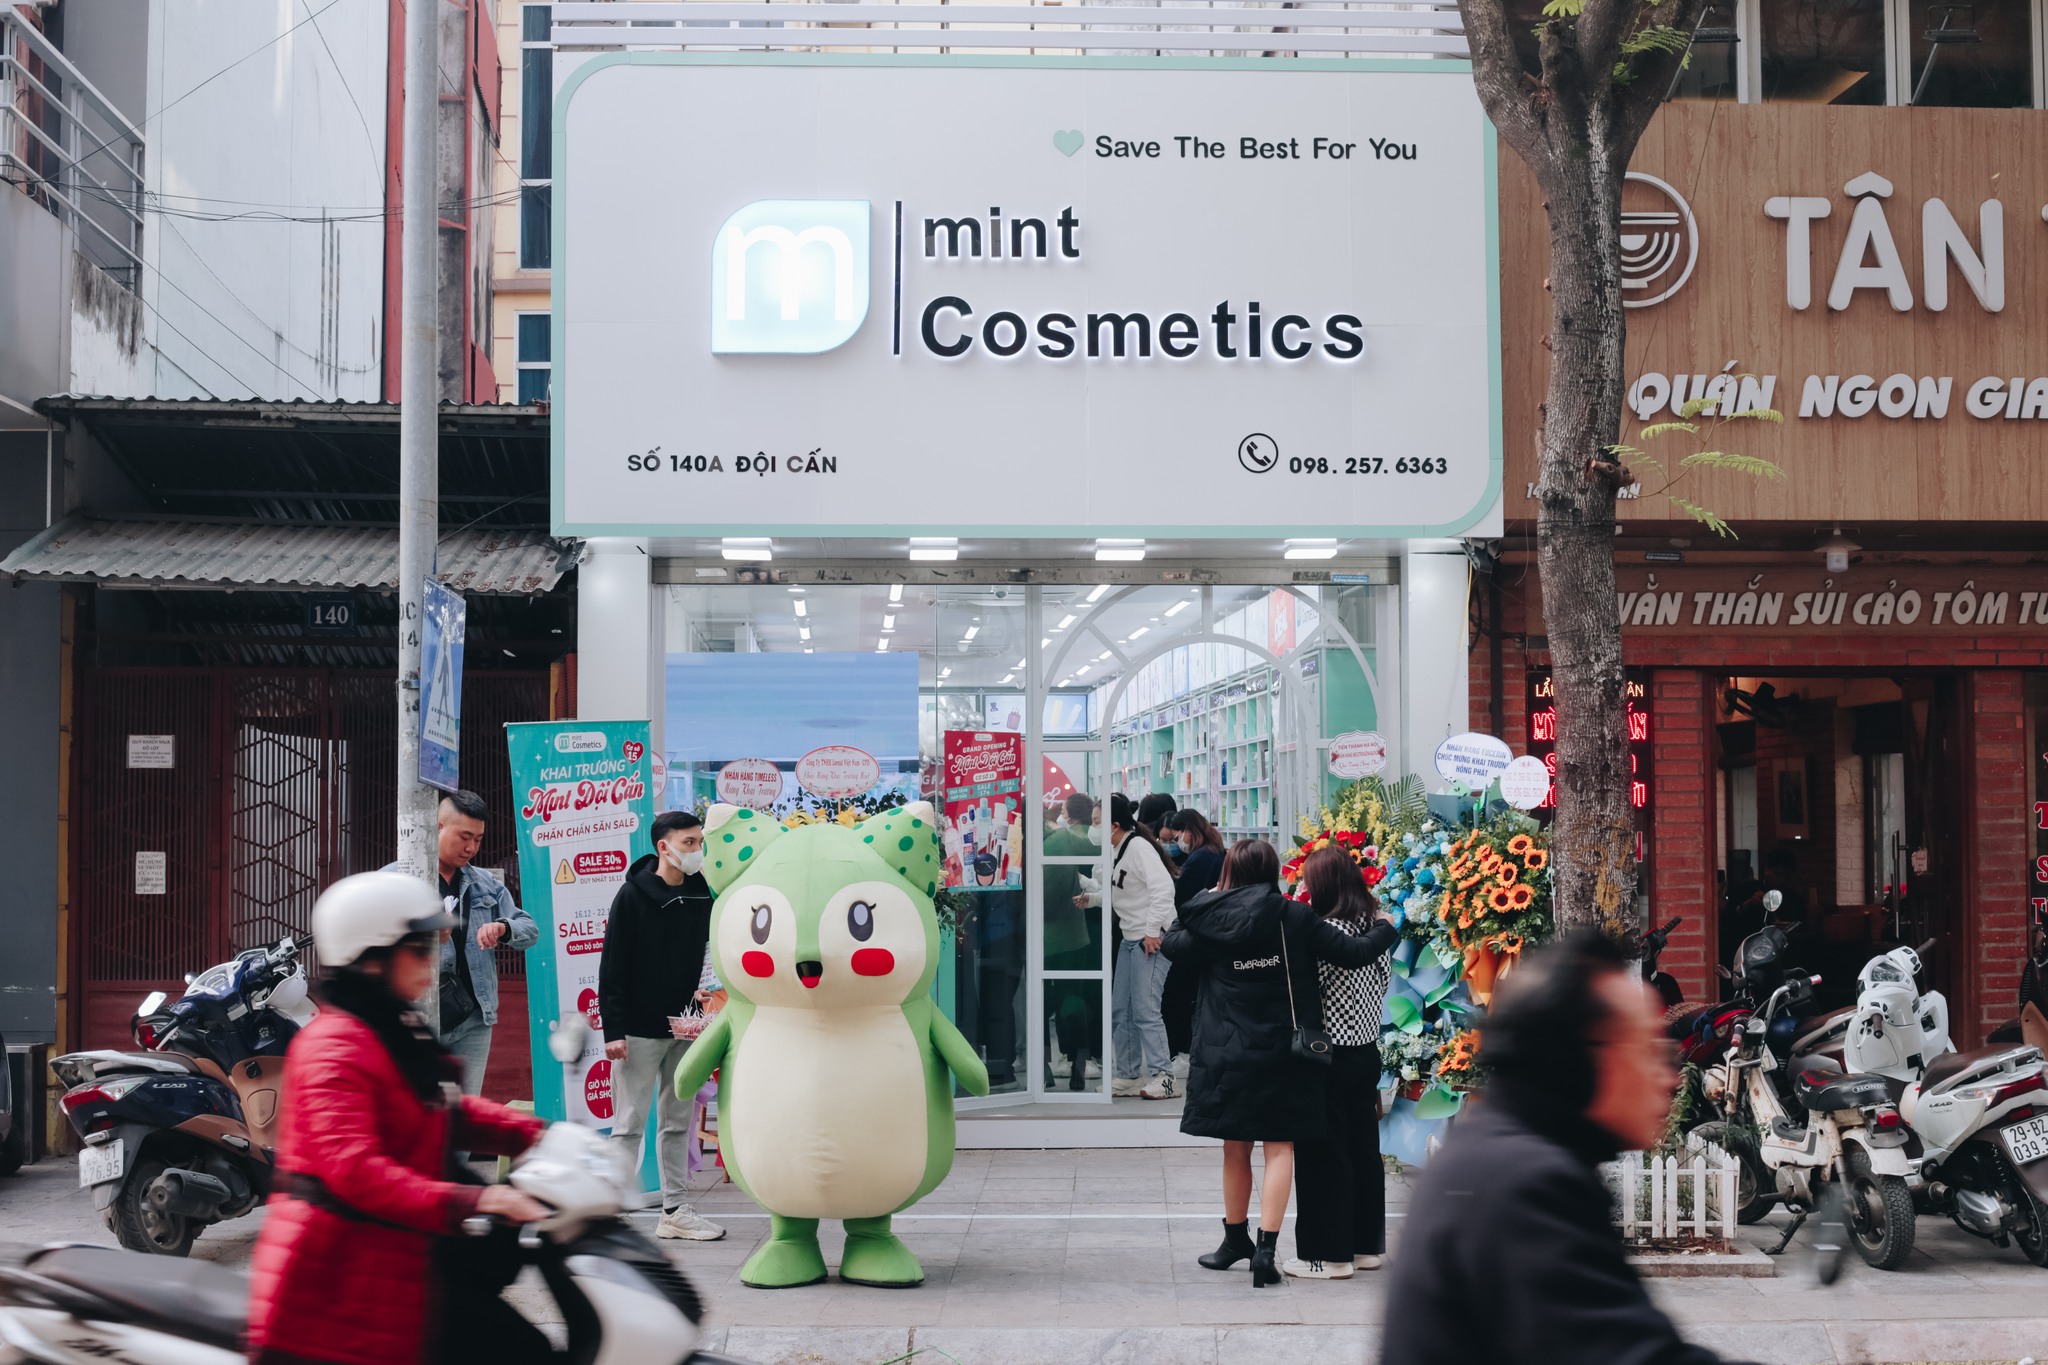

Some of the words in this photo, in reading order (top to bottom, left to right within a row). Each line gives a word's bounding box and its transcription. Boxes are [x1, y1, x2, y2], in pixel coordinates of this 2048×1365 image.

[1095, 136, 1161, 160] Save
[1174, 136, 1226, 160] The
[1239, 137, 1301, 160] Best
[1313, 137, 1357, 161] For
[1369, 138, 1418, 161] You
[922, 205, 1082, 259] mint
[1763, 171, 2005, 312] TÂN
[919, 295, 1366, 360] Cosmetics
[1627, 360, 1776, 421] QUÁN
[1799, 374, 1953, 419] NGON
[627, 446, 662, 474] SỐ
[670, 454, 724, 474] 140A
[735, 450, 777, 479] ĐỘI
[786, 447, 837, 474] CẤN
[1395, 457, 1449, 475] 6363
[1692, 574, 1784, 626] THẮN
[1788, 578, 1848, 625] SỦI
[1853, 579, 1922, 625] CẢO
[1932, 580, 2009, 625] TÔM
[314, 605, 350, 625] 140
[572, 740, 602, 749] Cosmetics
[983, 742, 1006, 750] OPENING
[1481, 748, 1507, 759] EUCERIN
[628, 752, 638, 760] 15
[1472, 757, 1486, 766] KHAI
[540, 766, 572, 781] KHAI
[575, 760, 626, 777] TRƯƠNG
[755, 772, 777, 782] TIMELESS
[523, 788, 572, 822] Mint
[574, 780, 611, 810] Đội
[611, 772, 644, 805] Cấn
[537, 826, 564, 842] PHẤN
[566, 822, 590, 837] CHẤN
[592, 820, 612, 833] SĂN
[614, 818, 635, 830] SALE
[580, 856, 602, 868] SALE
[604, 854, 622, 866] 30%
[575, 910, 591, 919] 16.12
[597, 908, 610, 916] 22.1
[559, 920, 594, 938] SALE
[569, 944, 583, 952] toàn
[584, 942, 592, 951] bộ
[579, 976, 595, 985] 16.12
[588, 1079, 600, 1089] GIỜ
[1857, 1083, 1887, 1092] HONDA
[587, 1090, 599, 1101] GIÁ
[2013, 1136, 2048, 1161] 039.3
